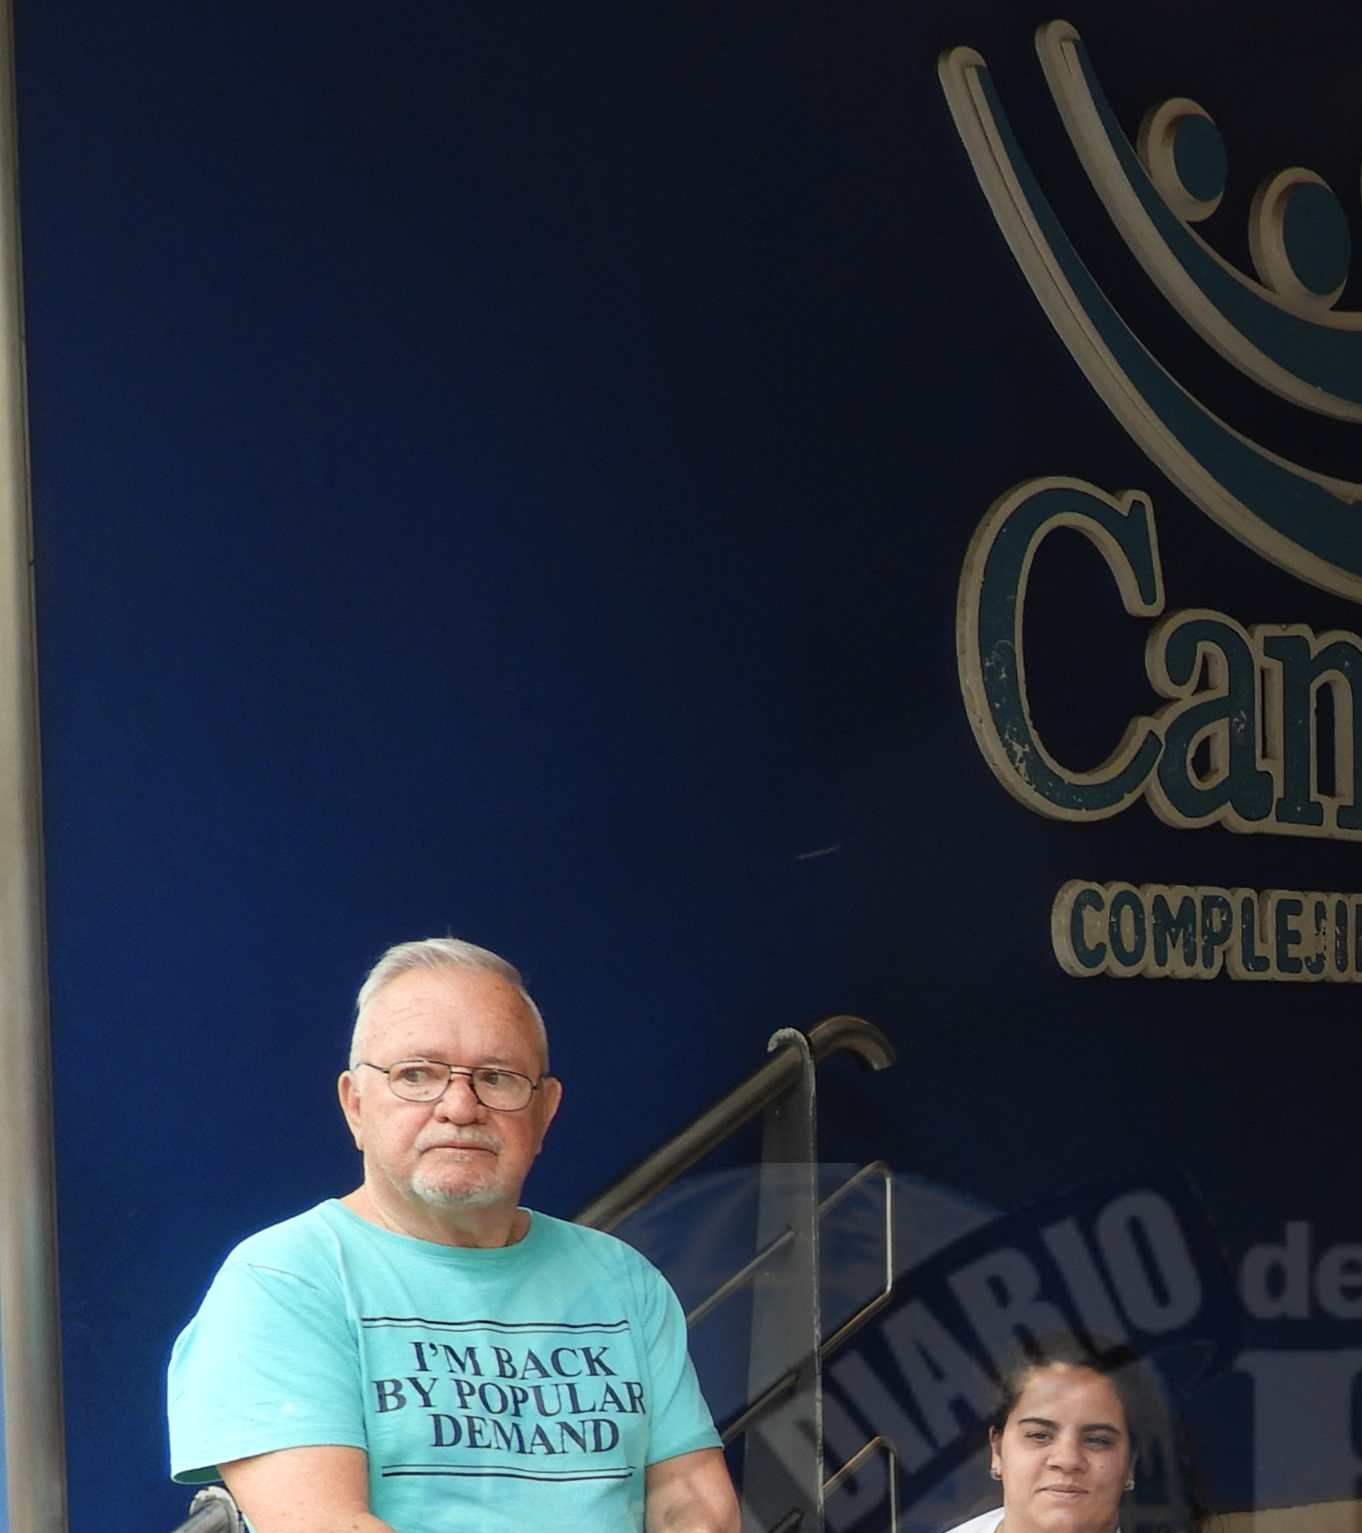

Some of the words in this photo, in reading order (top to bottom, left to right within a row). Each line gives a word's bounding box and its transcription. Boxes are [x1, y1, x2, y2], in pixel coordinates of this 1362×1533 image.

[408, 1341, 485, 1378] I'M
[489, 1343, 619, 1380] BACK
[372, 1378, 439, 1415] BY
[454, 1378, 647, 1419] POPULAR
[429, 1412, 620, 1457] DEMAND
